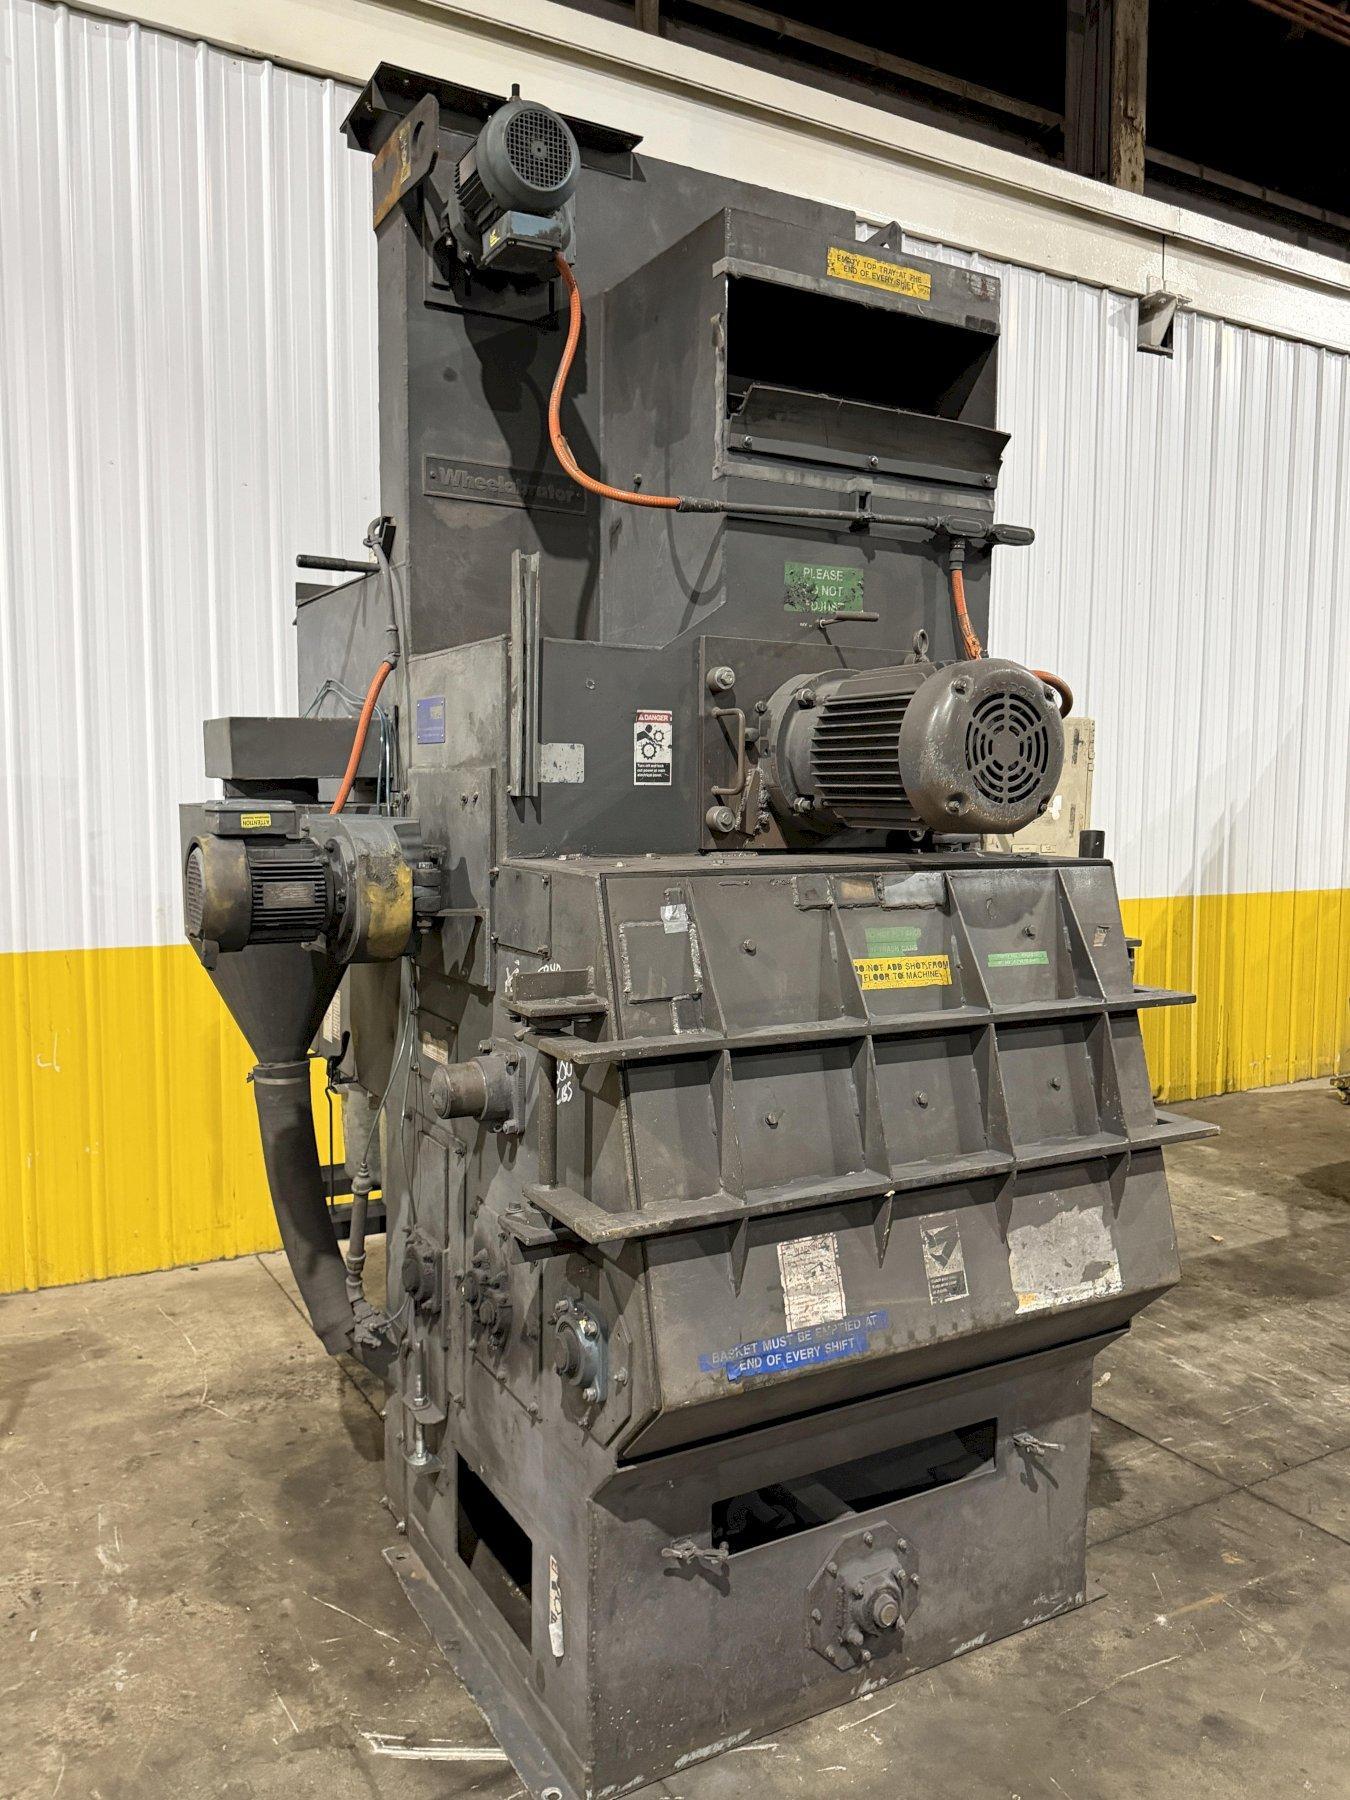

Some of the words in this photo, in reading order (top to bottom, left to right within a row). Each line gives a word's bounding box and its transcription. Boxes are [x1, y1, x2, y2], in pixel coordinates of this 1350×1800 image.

[843, 265, 858, 276] END
[860, 269, 870, 278] OF
[871, 272, 894, 285] EVERY
[863, 261, 877, 271] TOP
[879, 265, 896, 277] TRAY
[898, 270, 908, 279] AT
[803, 567, 844, 582] PLEASE
[821, 585, 845, 597] NOT
[644, 713, 669, 721] DANGER
[866, 963, 884, 972] NOT
[887, 962, 903, 971] ADD
[926, 960, 949, 969] FROM
[863, 973, 890, 982] FLOOR
[893, 971, 904, 980] TO
[712, 1342, 758, 1364] BASKET
[762, 1333, 793, 1352] MUST
[798, 1331, 812, 1343] BE
[865, 1314, 877, 1327] AT
[739, 1356, 763, 1372] END
[767, 1353, 781, 1367] OF
[785, 1346, 821, 1365] EVERY
[825, 1338, 855, 1355] SHIFT
